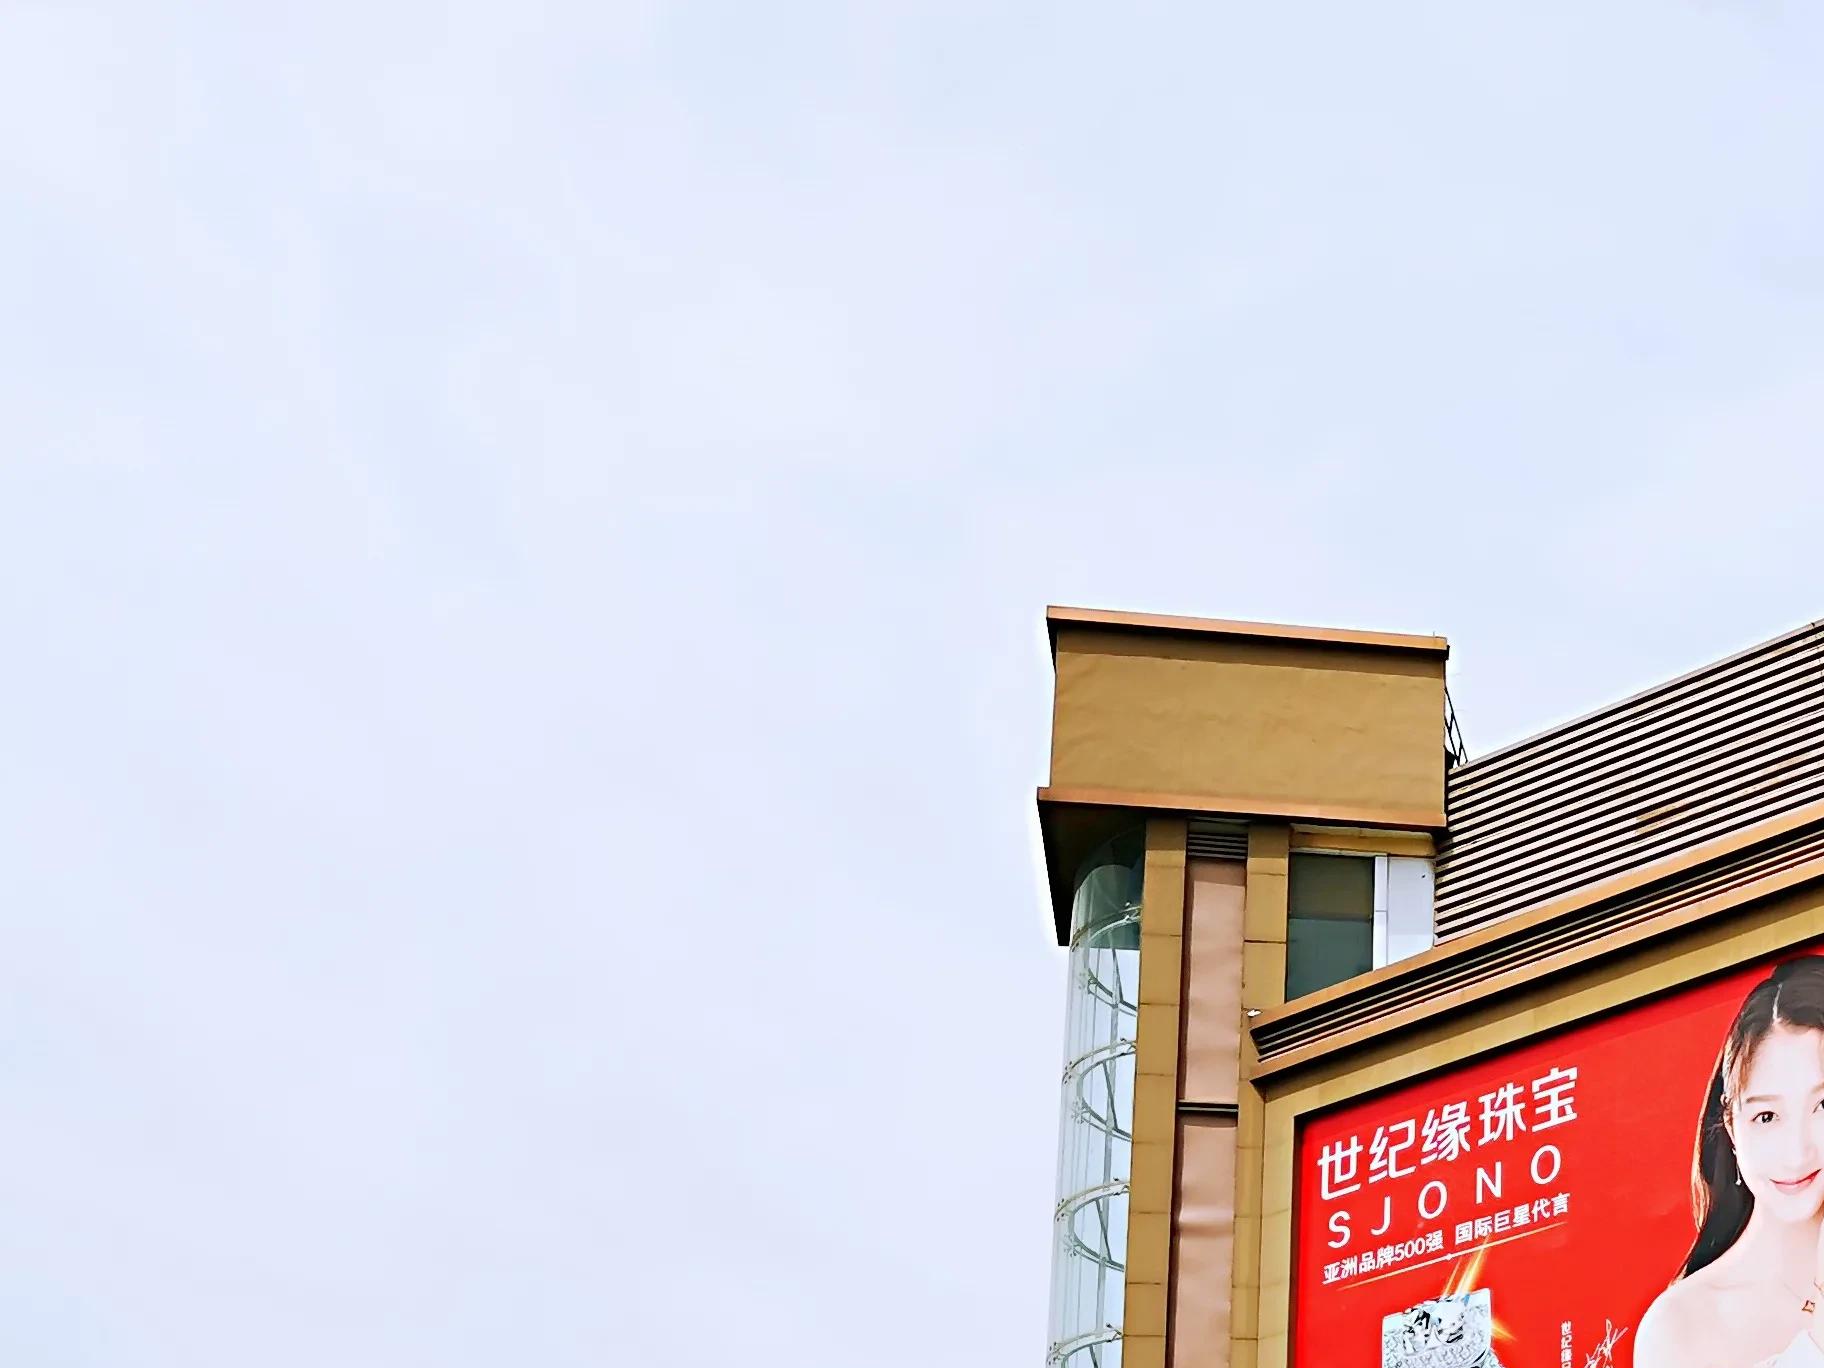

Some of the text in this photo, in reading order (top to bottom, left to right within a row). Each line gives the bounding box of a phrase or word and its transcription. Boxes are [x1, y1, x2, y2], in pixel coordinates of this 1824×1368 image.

[1318, 1066, 1578, 1201] 世纪缘珠宝
[1322, 1191, 1571, 1285] 亚洲品牌500强 国际巨星代言
[1327, 1144, 1562, 1249] SJONO
